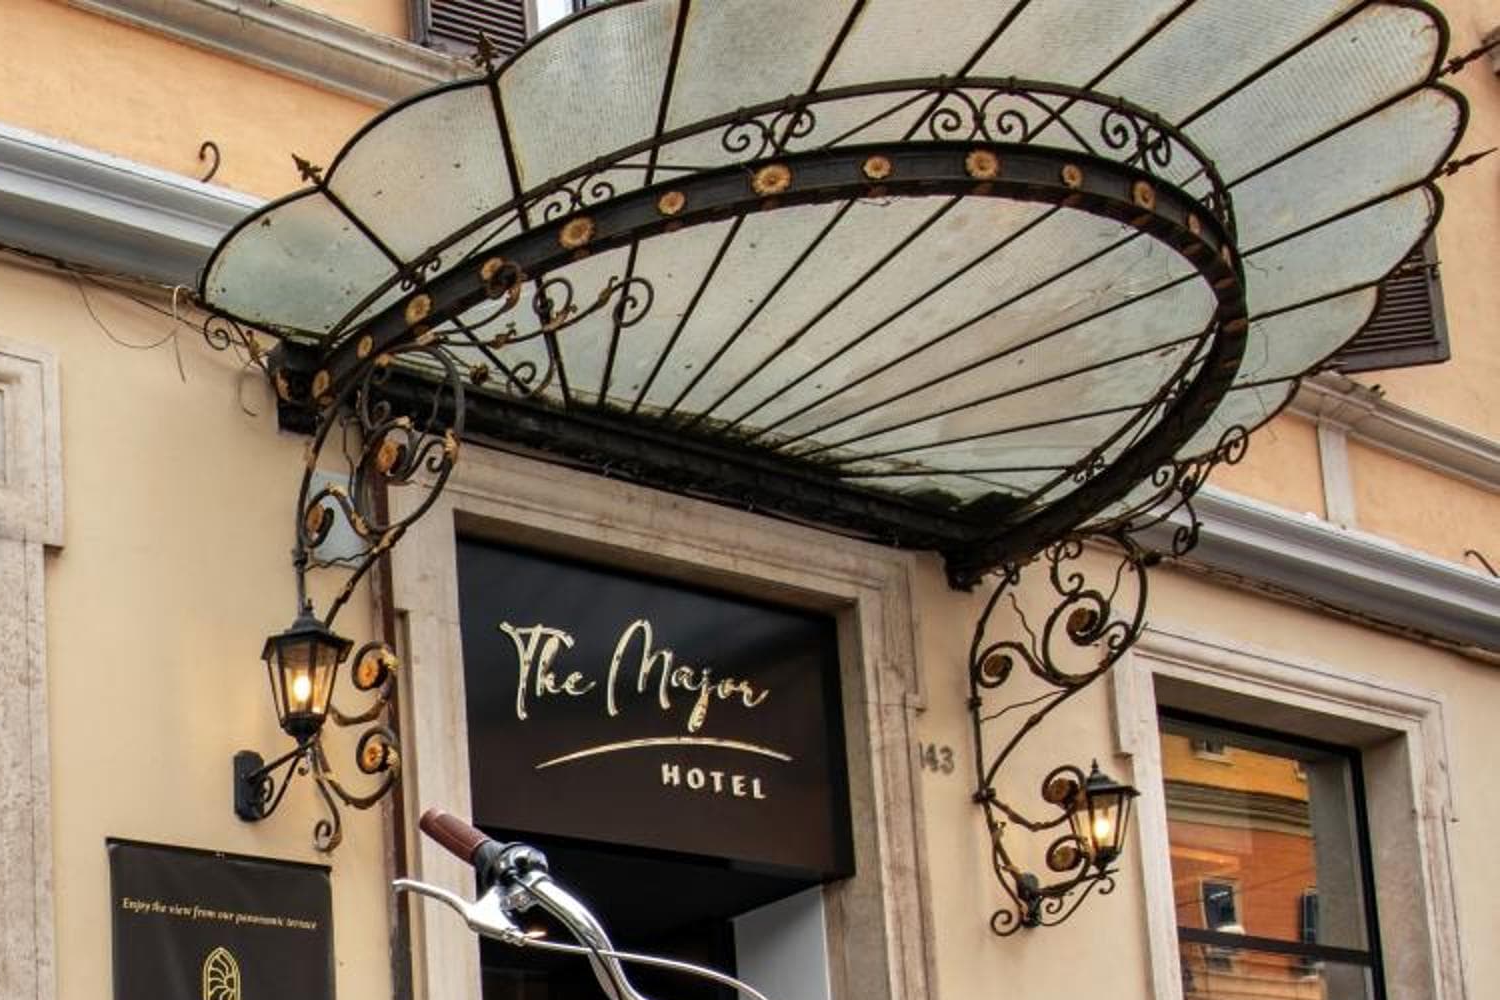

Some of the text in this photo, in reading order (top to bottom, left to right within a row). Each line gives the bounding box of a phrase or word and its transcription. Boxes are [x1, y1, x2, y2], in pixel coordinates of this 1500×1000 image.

[500, 619, 769, 733] The Major
[918, 742, 955, 775] 143
[661, 763, 767, 799] HOTEL
[122, 897, 151, 914] Enjoy
[151, 900, 167, 913] the
[169, 903, 191, 916] view
[192, 905, 216, 920] from
